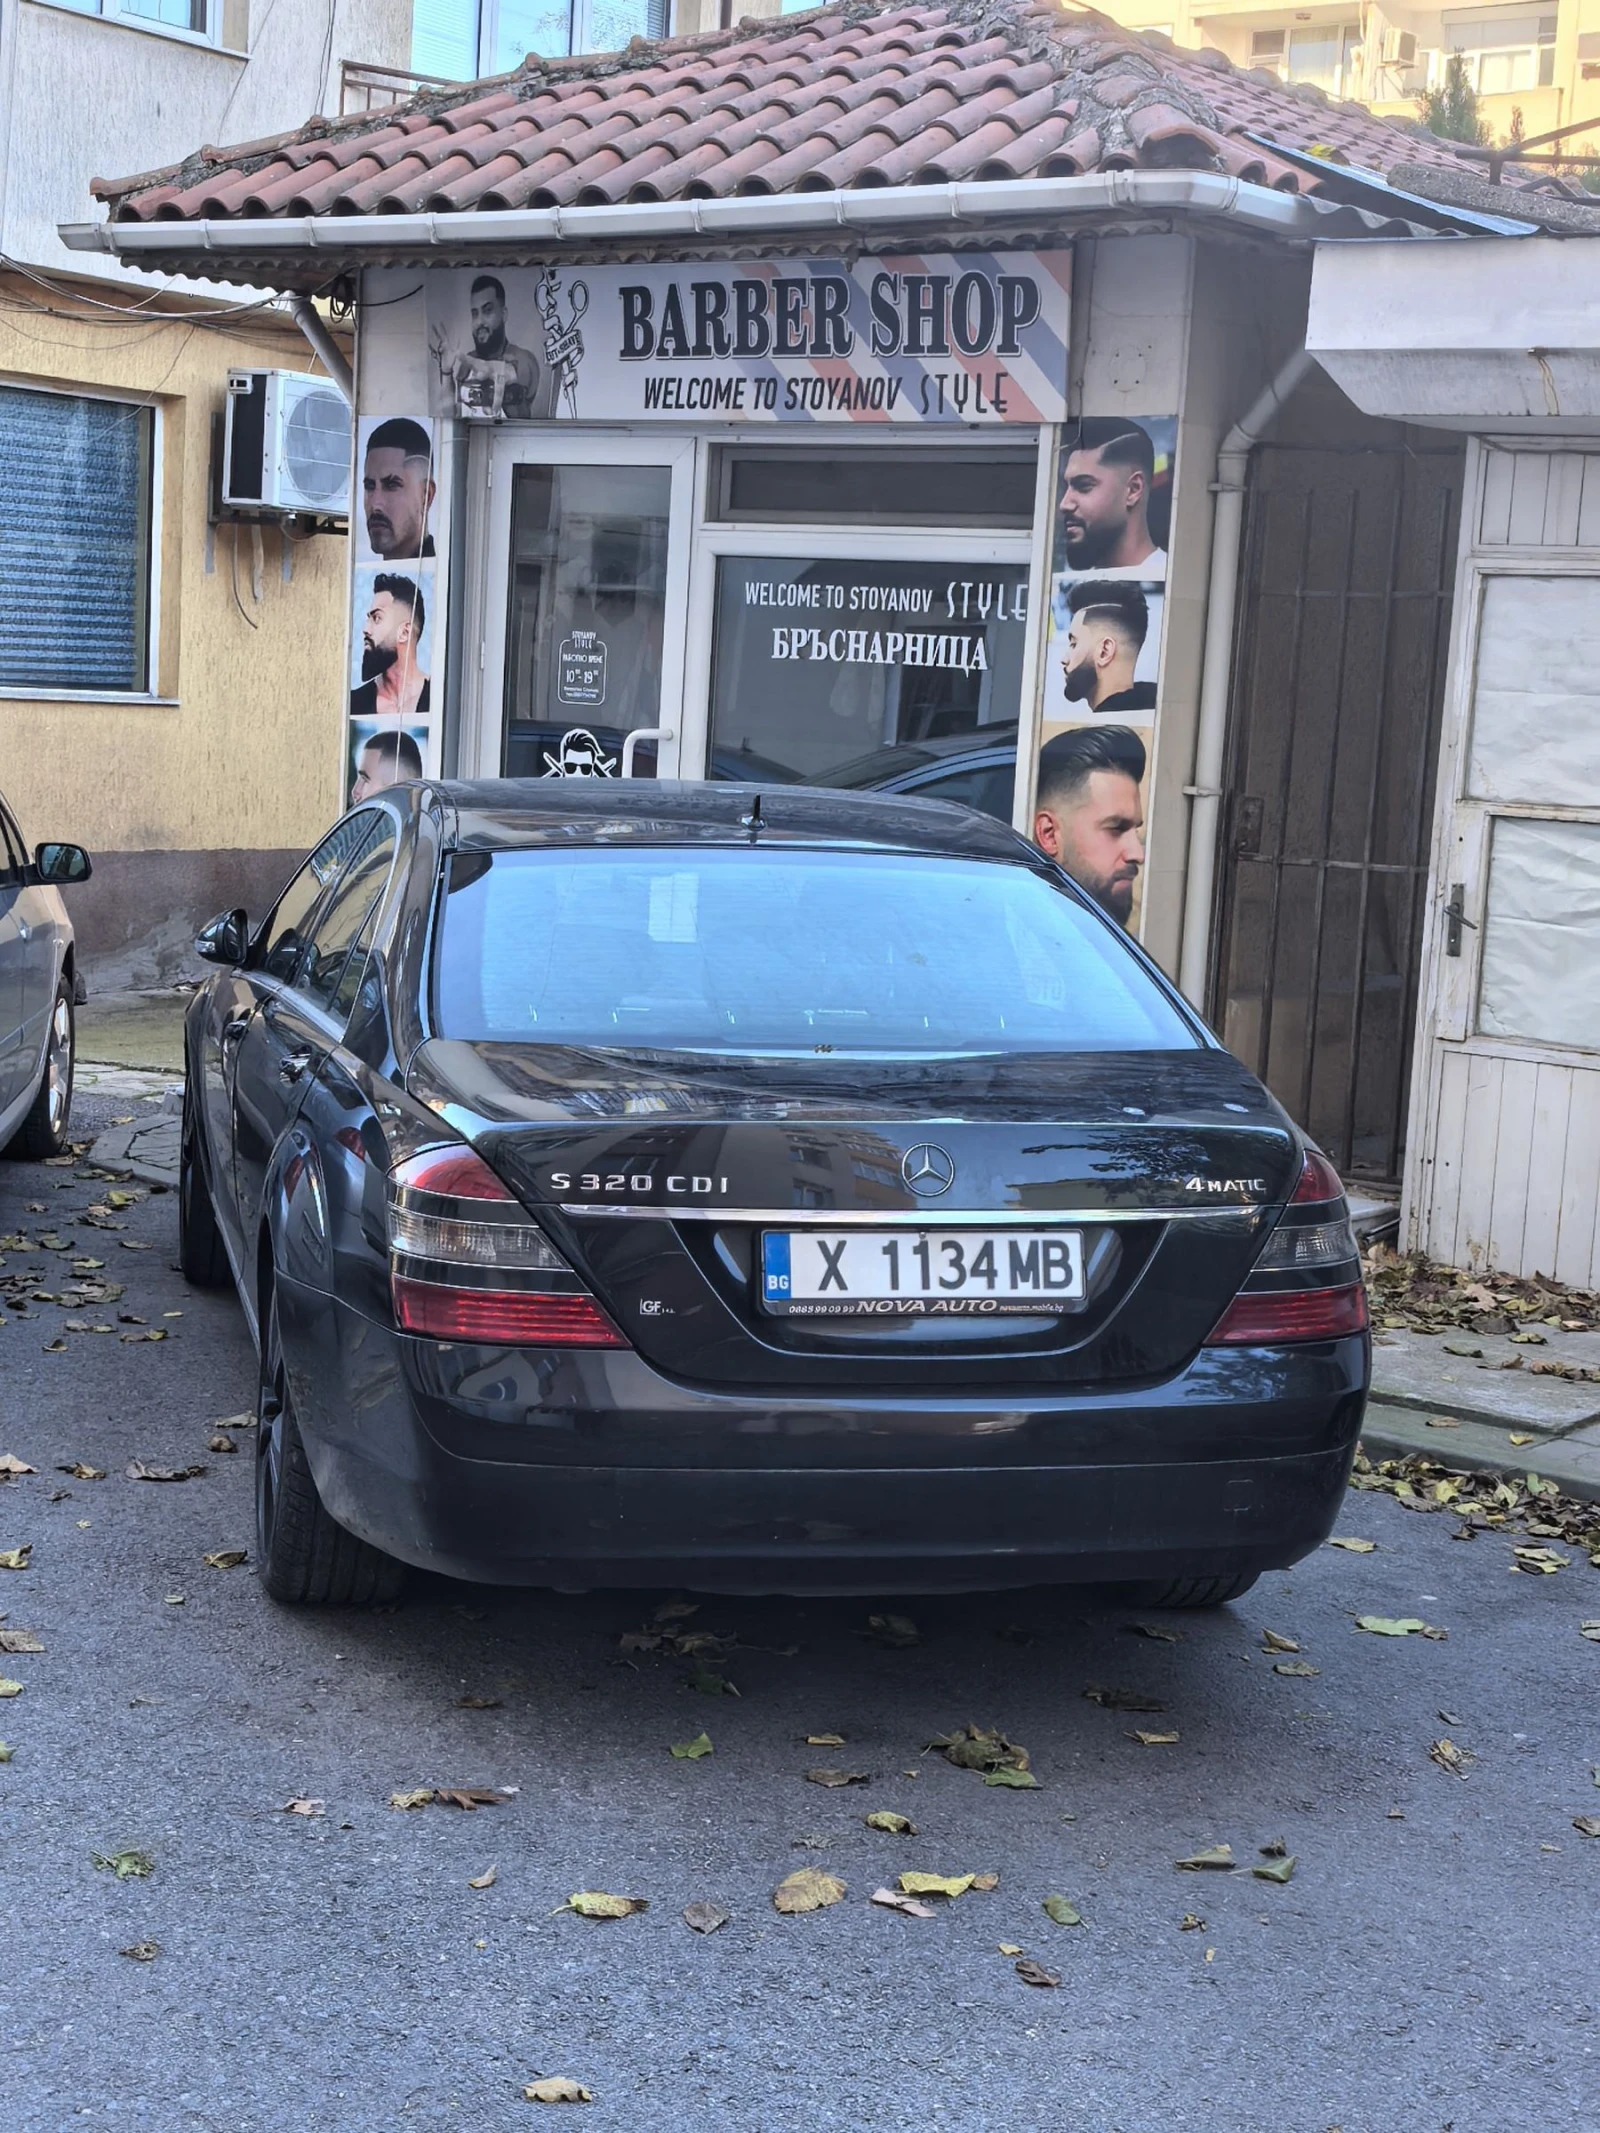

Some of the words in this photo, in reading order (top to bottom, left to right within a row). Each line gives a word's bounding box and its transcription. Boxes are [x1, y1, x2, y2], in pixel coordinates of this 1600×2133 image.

[619, 277, 856, 361] BARBER
[870, 270, 1042, 358] SHOP
[644, 377, 747, 410] WELCOME
[754, 377, 778, 410] TO
[784, 377, 903, 411] STOYANOV
[920, 371, 1008, 415] STYLE
[745, 582, 821, 608] WELCOME
[825, 585, 844, 609] TO
[849, 586, 933, 613] STOYANOV
[947, 581, 1028, 621] STYLE
[771, 628, 988, 678] БРЪСНАРНИЦА
[550, 1173, 571, 1190] S
[579, 1174, 653, 1191] 320
[666, 1176, 728, 1193] CDI
[1185, 1177, 1267, 1193] 4MATIC
[767, 1276, 790, 1290] BG
[817, 1240, 849, 1291] X
[881, 1240, 998, 1291] 1134
[1008, 1240, 1074, 1290] MB
[856, 1300, 926, 1313] NOVA
[930, 1300, 998, 1312] AUTO
